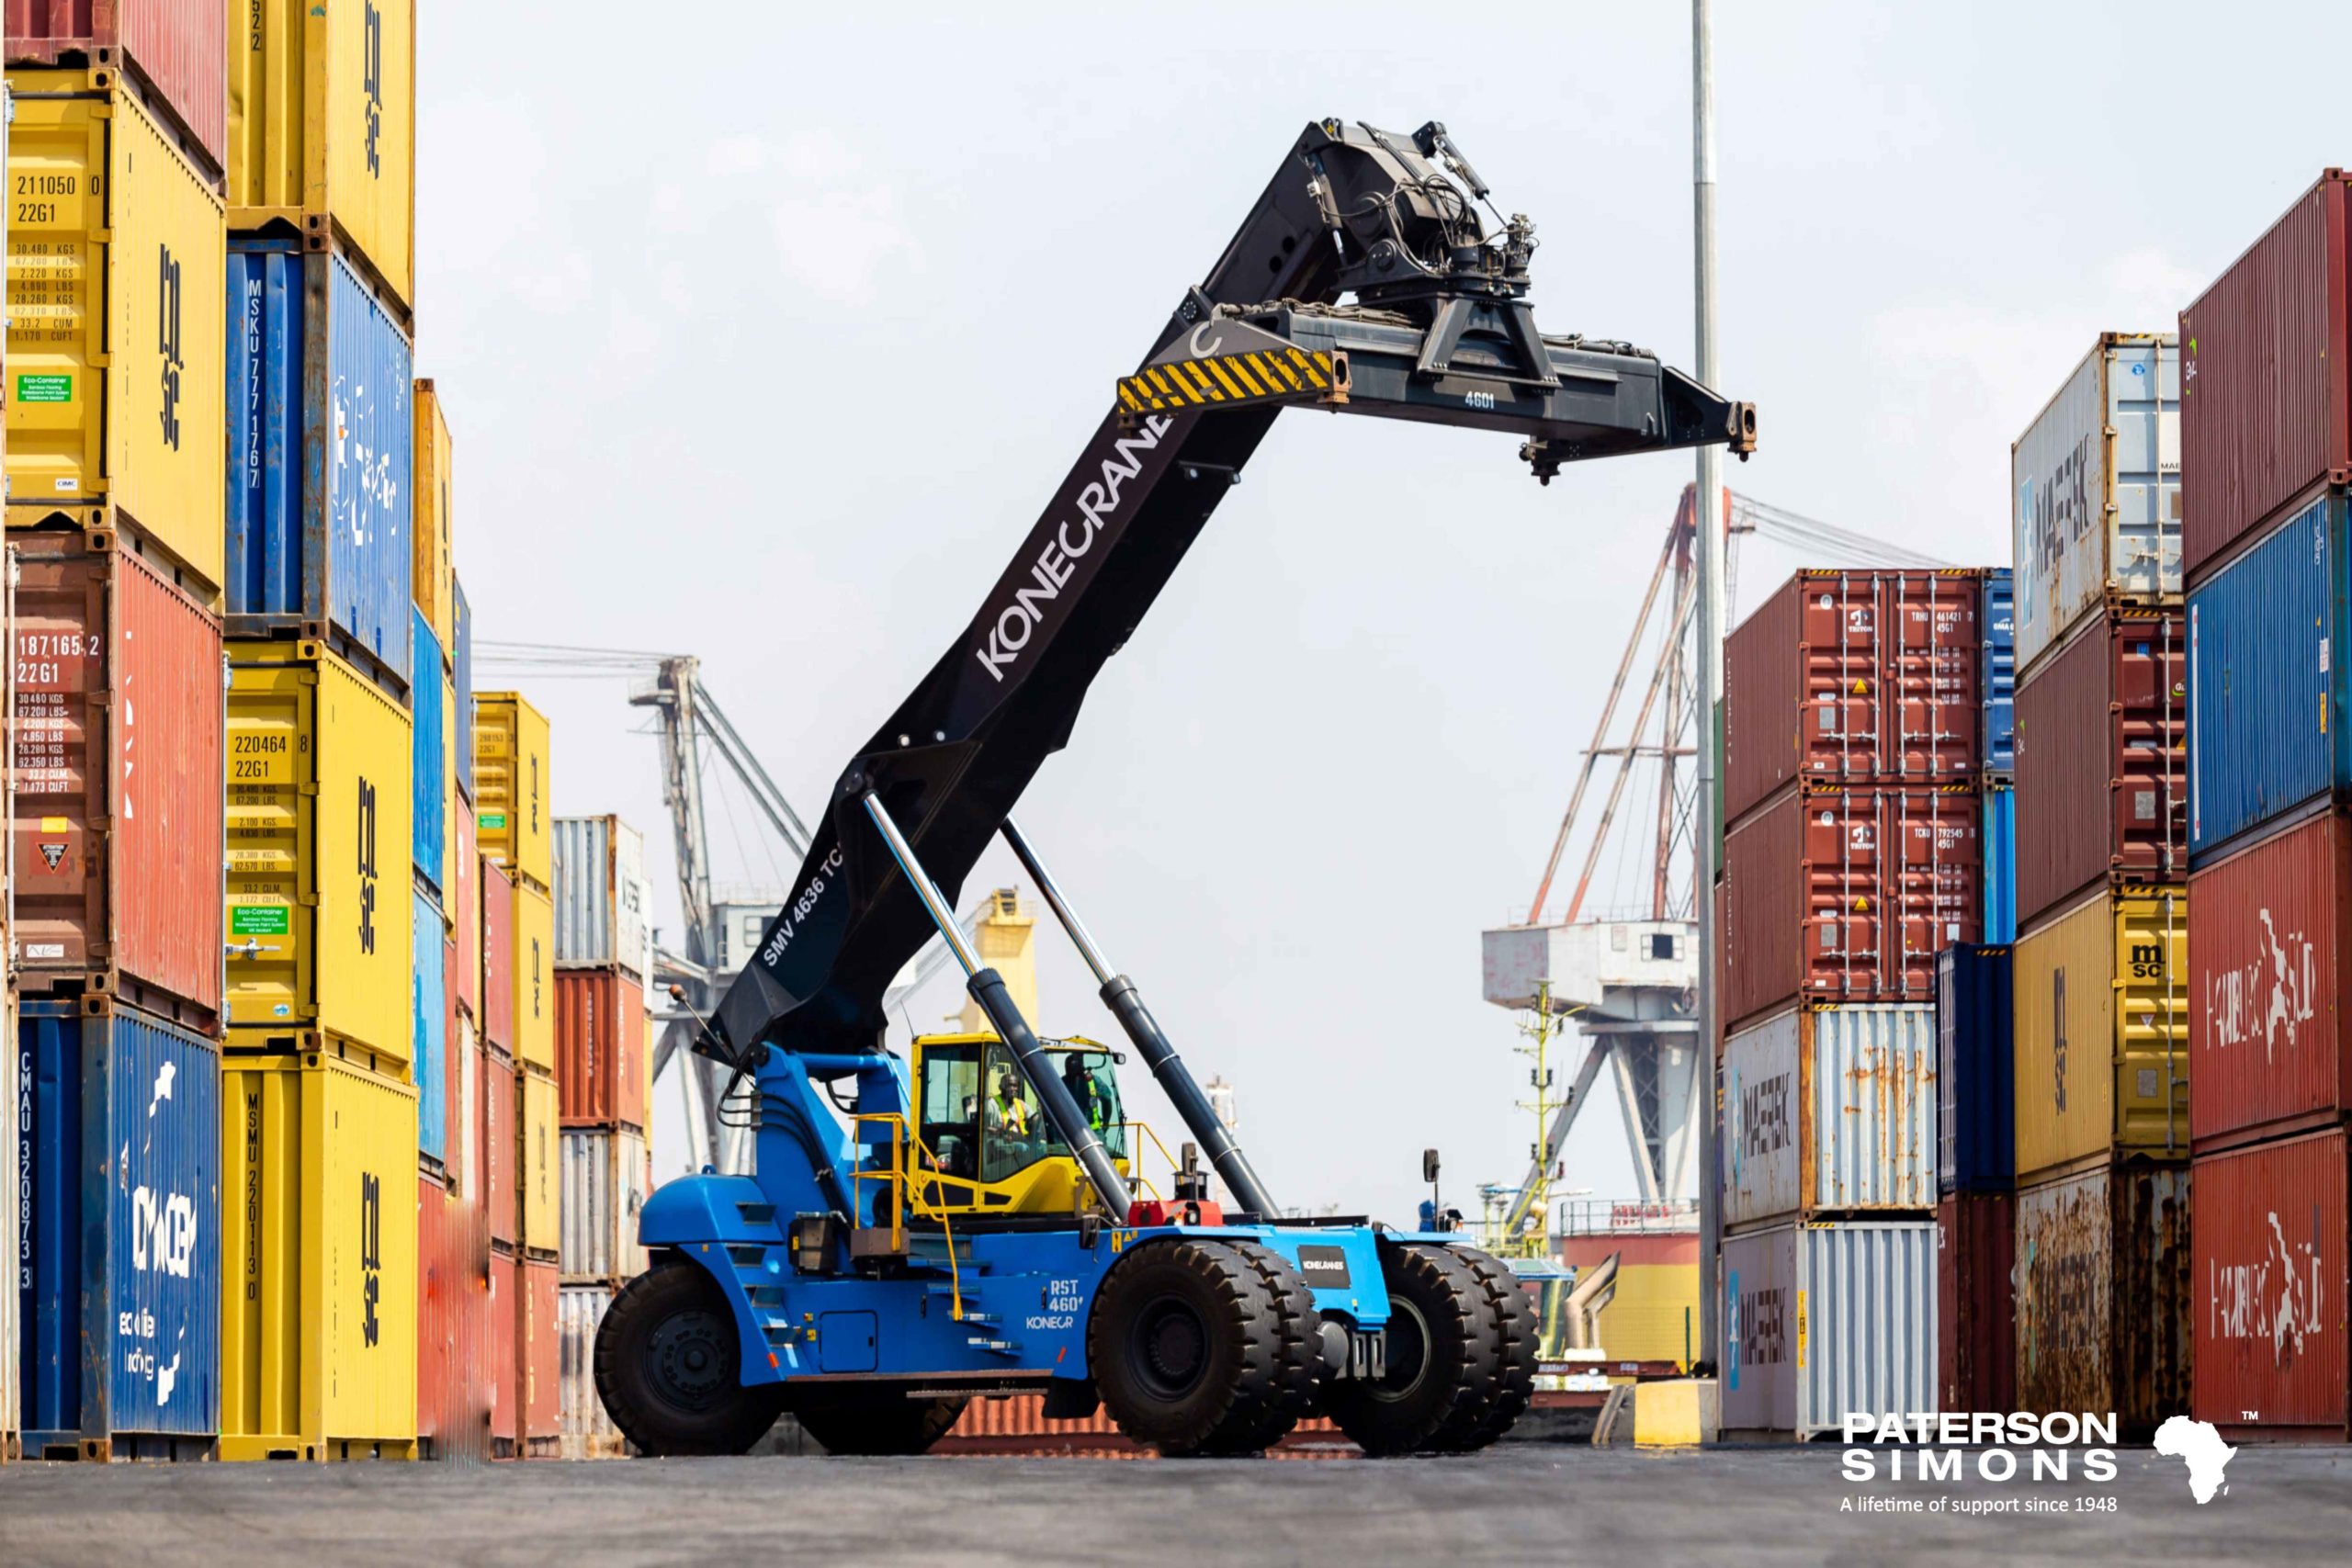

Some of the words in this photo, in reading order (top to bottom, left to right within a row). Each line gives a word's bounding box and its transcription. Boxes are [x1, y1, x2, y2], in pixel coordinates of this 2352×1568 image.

[17, 175, 75, 195] 211050
[91, 175, 100, 195] 0
[18, 203, 55, 222] 22G1
[16, 243, 48, 254] 30.480
[57, 243, 74, 254] KGS
[20, 268, 47, 278] 2.220
[55, 268, 74, 278] KGS
[55, 281, 74, 291] LBS
[56, 294, 74, 304] KGS
[53, 318, 73, 328] CUM
[249, 279, 261, 353] MSKU
[51, 332, 73, 341] CUFT
[1464, 390, 1495, 410] 4601
[1911, 611, 1928, 623] TRHU
[1936, 611, 1962, 623] 461421
[1936, 623, 1953, 633] 45G1
[19, 635, 81, 656] 187165
[89, 635, 99, 656] 2
[17, 662, 58, 683] 22G1
[49, 693, 64, 705] KGS
[48, 731, 63, 742] LBS
[48, 744, 64, 754] KGS
[235, 736, 287, 753] 220464
[300, 735, 308, 752] 8
[49, 756, 64, 768] LBS
[235, 760, 268, 778] 22G1
[1938, 828, 1963, 839] 792545
[1938, 839, 1955, 850] 45G1
[237, 908, 283, 916] Eco-Container
[763, 919, 795, 967] SMV
[793, 876, 825, 924] 4636
[20, 1052, 32, 1132] CMAU
[247, 1093, 258, 1163] MSMU
[20, 1140, 31, 1259] 320873
[247, 1169, 257, 1274] 220113
[21, 1268, 31, 1289] 3
[1050, 1279, 1079, 1295] RST
